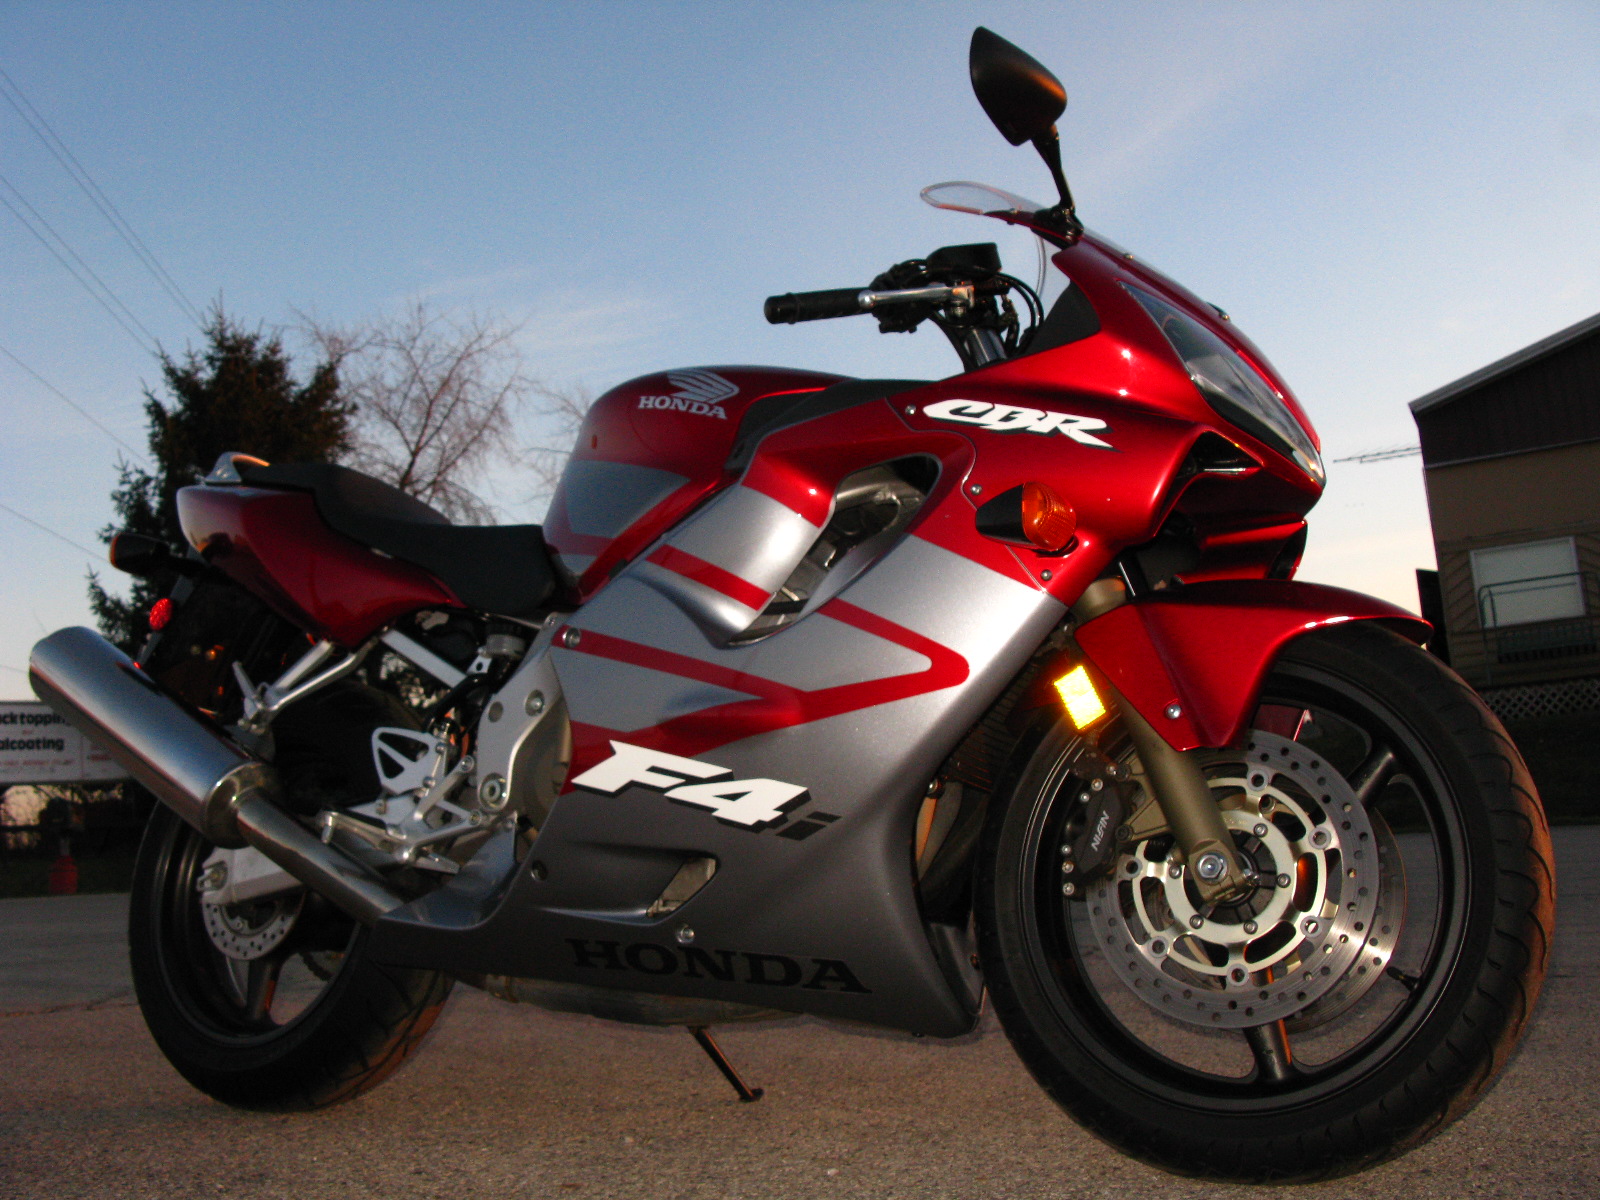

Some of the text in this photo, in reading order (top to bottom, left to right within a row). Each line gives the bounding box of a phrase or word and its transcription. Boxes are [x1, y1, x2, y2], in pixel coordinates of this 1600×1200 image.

[638, 395, 728, 420] HONDA
[922, 398, 1123, 453] CBR
[564, 937, 873, 994] HONDA
